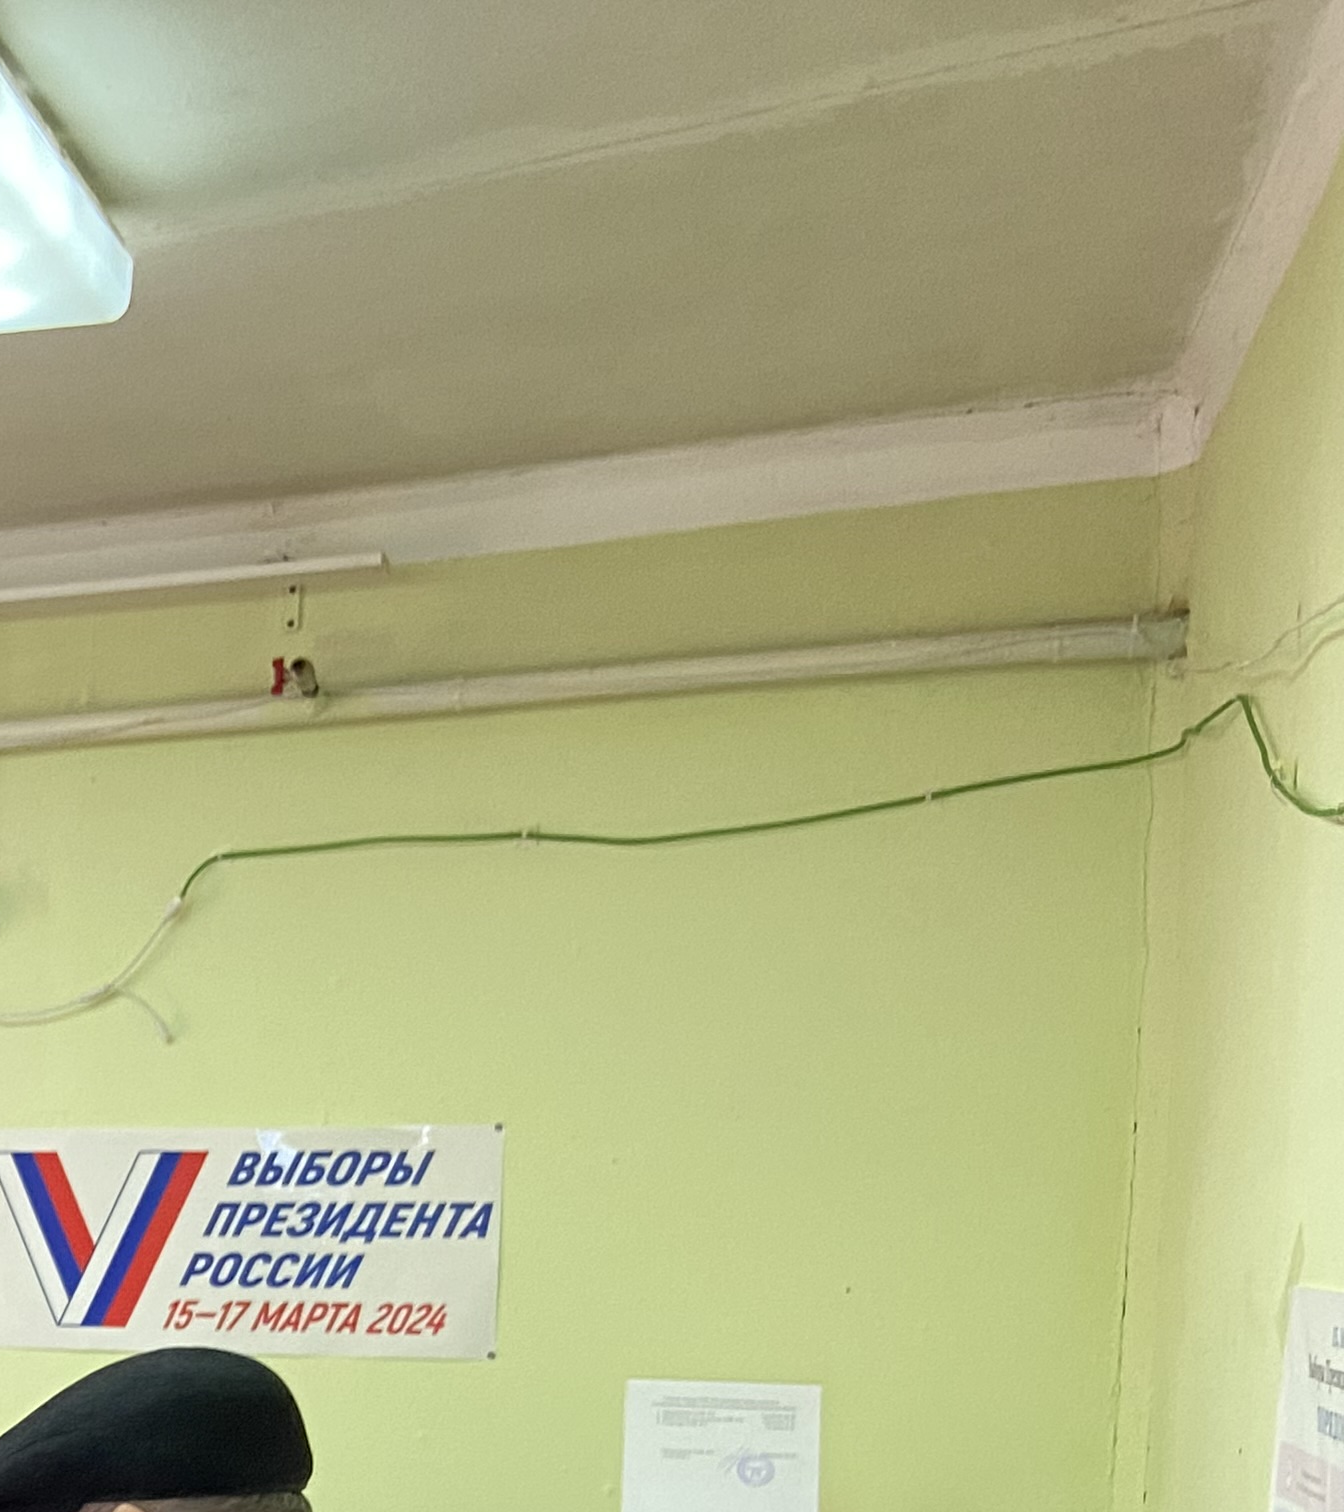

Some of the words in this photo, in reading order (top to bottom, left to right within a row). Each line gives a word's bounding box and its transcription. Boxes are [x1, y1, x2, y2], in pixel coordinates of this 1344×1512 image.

[227, 1150, 435, 1187] ВЫБОРЫ
[203, 1202, 494, 1243] ПРЕЗИДЕНТА
[179, 1253, 365, 1289] РОССИИ
[251, 1302, 358, 1334] МАРТА
[365, 1303, 448, 1336] 2024
